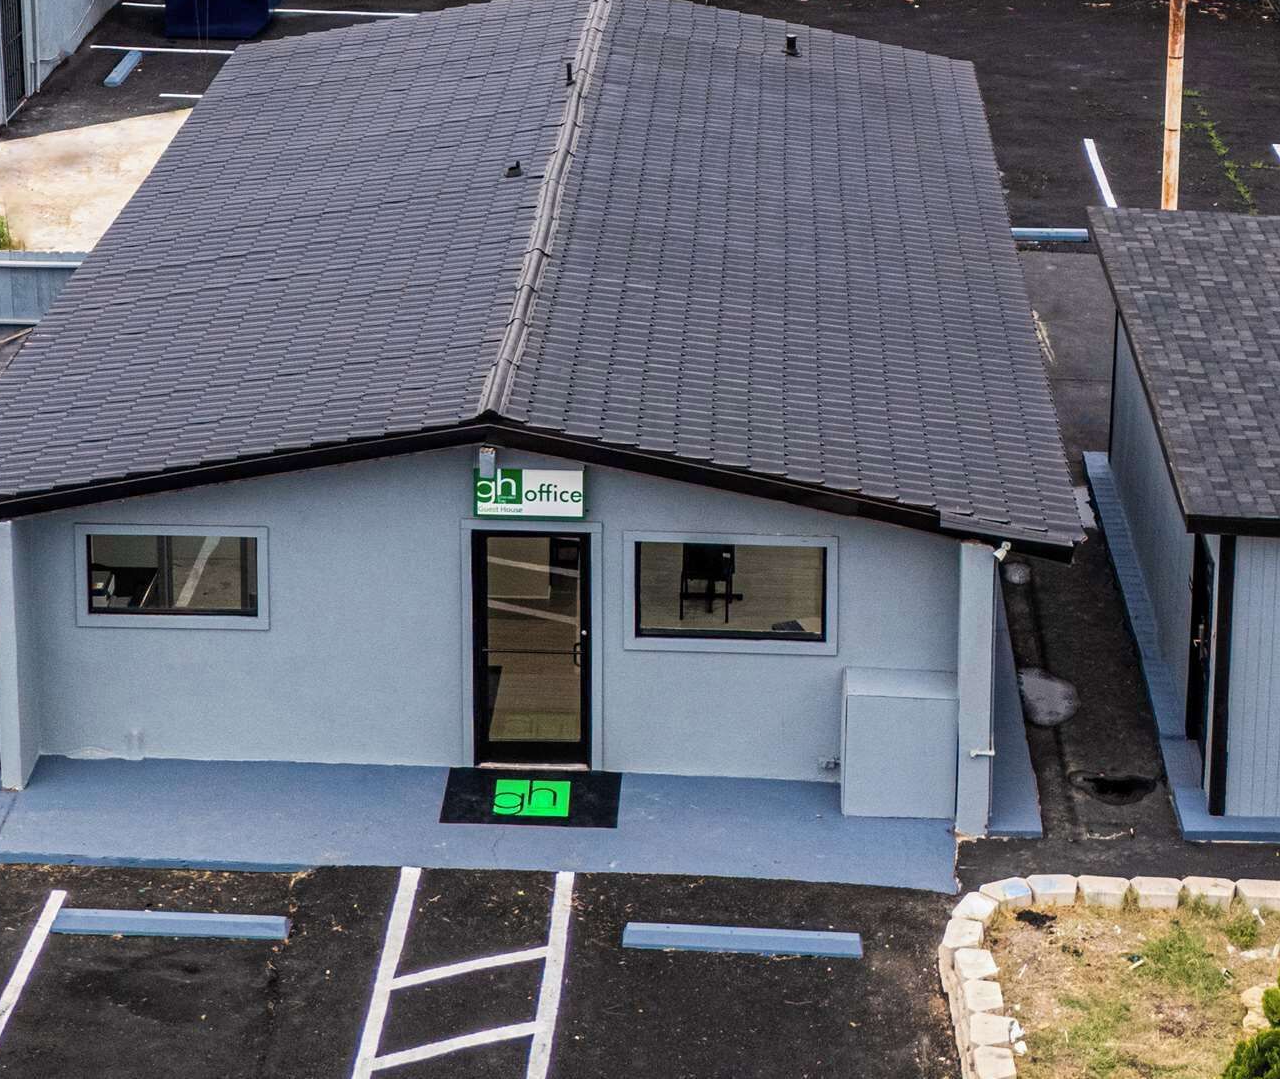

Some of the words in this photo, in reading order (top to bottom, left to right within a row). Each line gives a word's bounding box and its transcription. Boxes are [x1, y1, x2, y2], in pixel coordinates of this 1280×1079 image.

[525, 483, 583, 503] office
[478, 504, 499, 512] Guest
[501, 504, 523, 513] House
